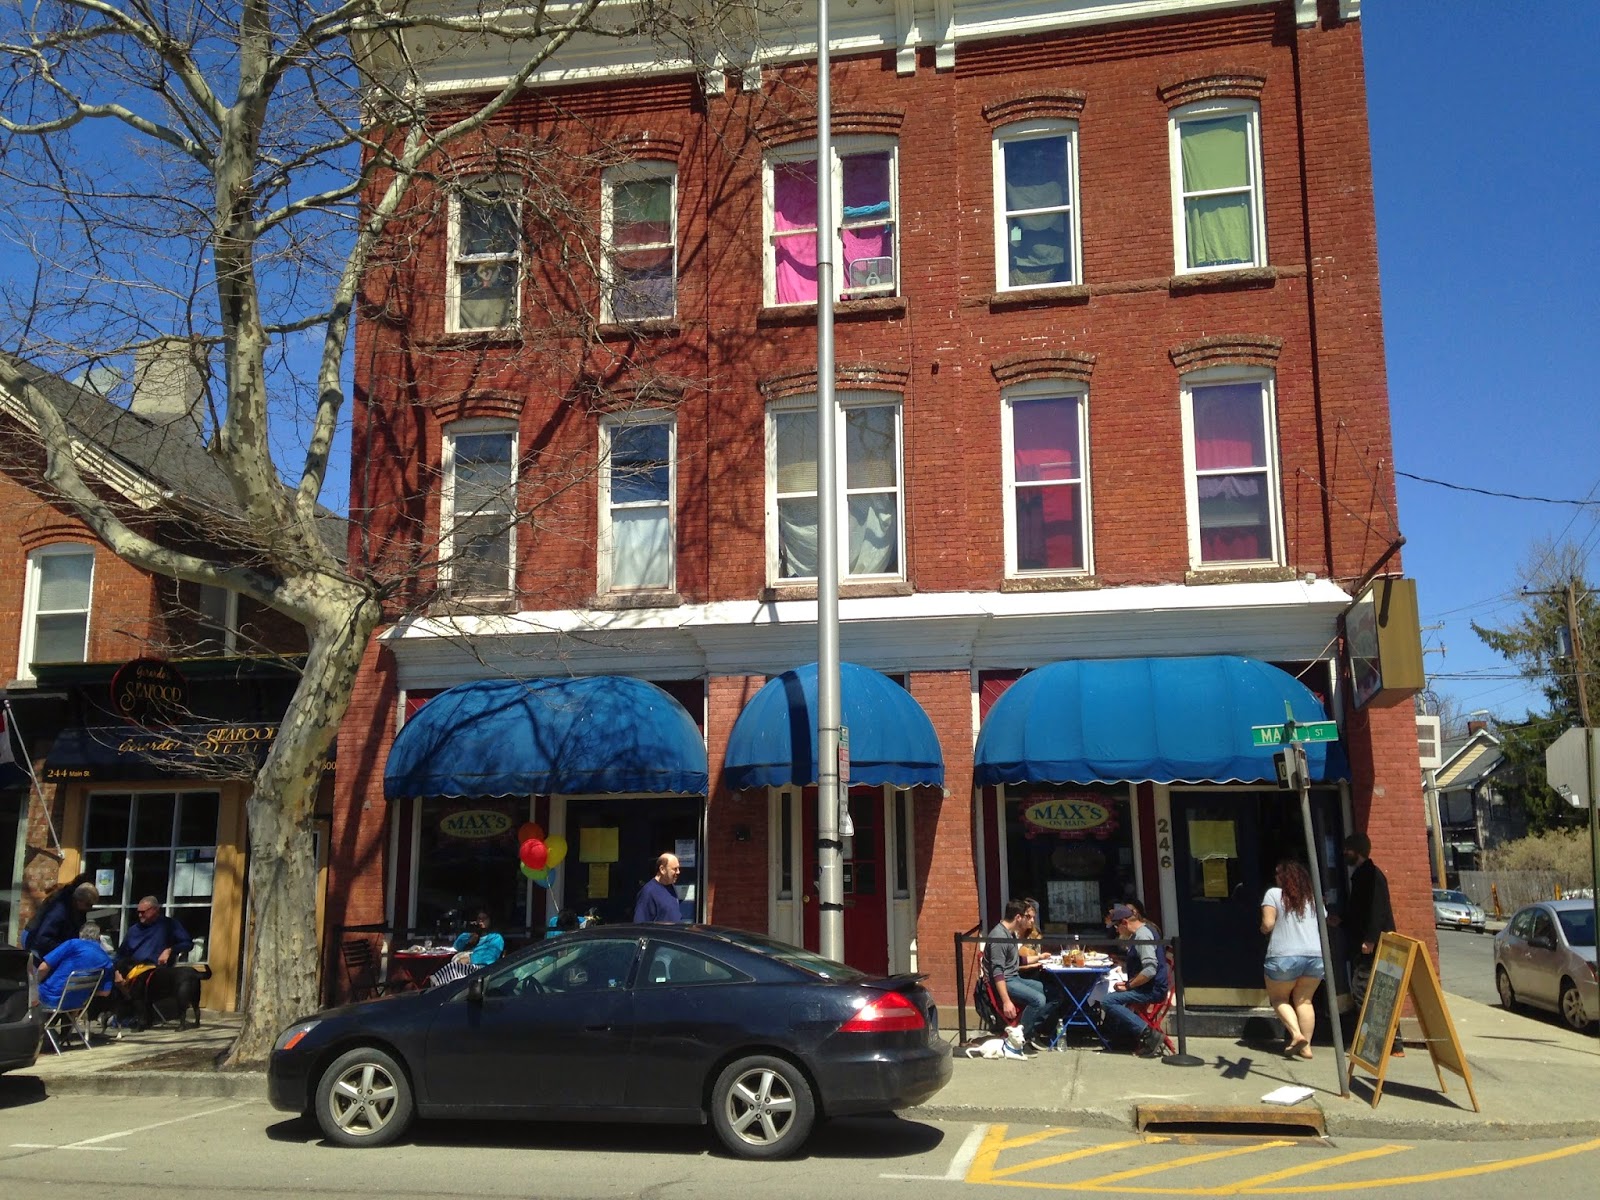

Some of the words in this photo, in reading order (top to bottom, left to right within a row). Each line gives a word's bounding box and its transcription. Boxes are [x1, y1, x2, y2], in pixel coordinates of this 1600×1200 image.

[1260, 728, 1299, 744] MAN
[1314, 728, 1324, 737] ST
[47, 769, 67, 778] 244
[1032, 803, 1103, 820] MAX'S
[447, 814, 507, 829] MAX'S
[1157, 818, 1172, 869] 246
